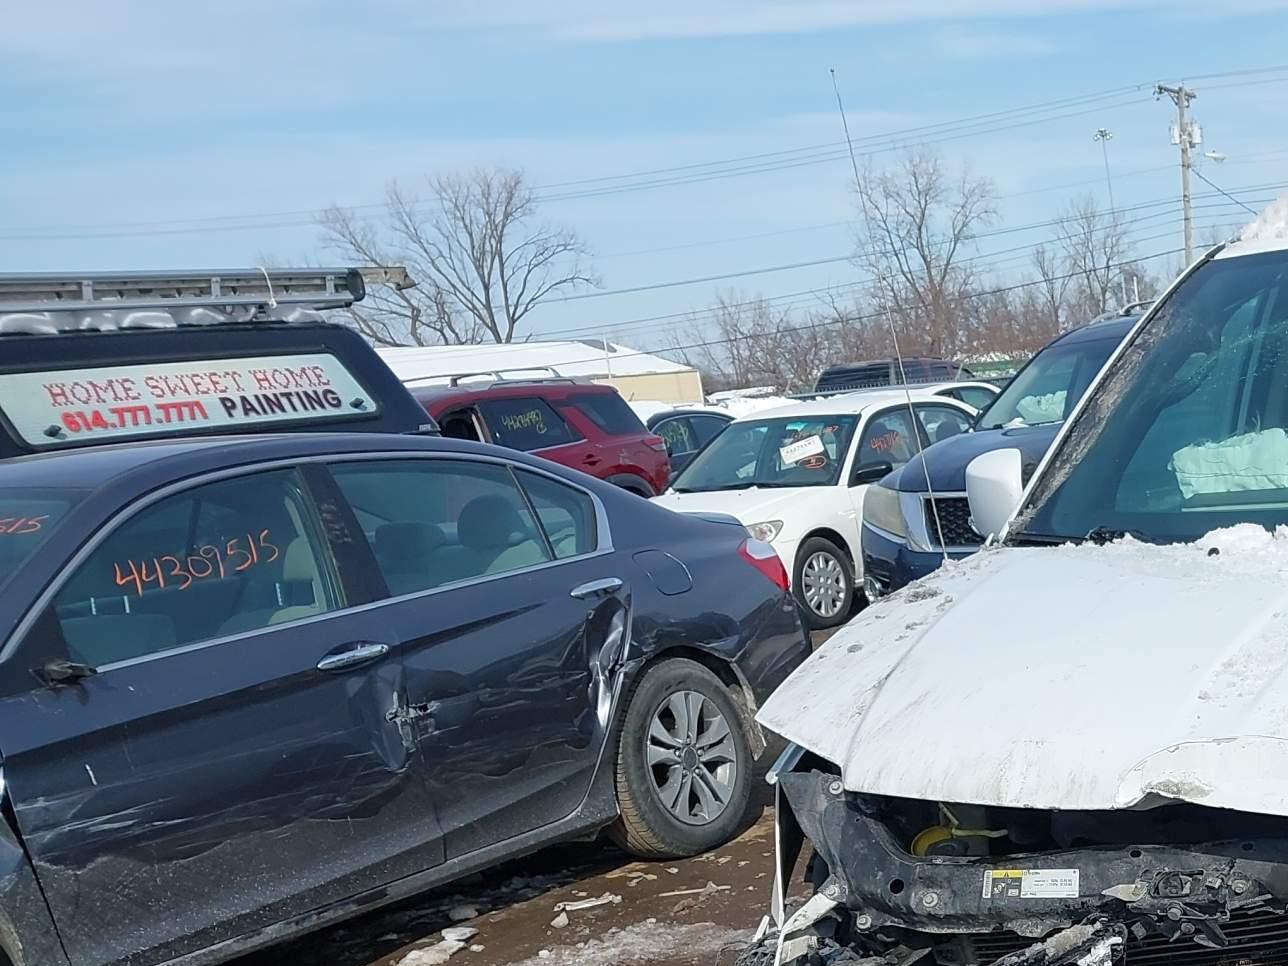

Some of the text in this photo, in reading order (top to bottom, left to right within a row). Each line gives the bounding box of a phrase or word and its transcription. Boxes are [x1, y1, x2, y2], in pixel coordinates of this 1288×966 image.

[43, 365, 331, 407] HOME SWEET HOME
[218, 388, 342, 418] PAINTING
[113, 528, 279, 597] 44309515
